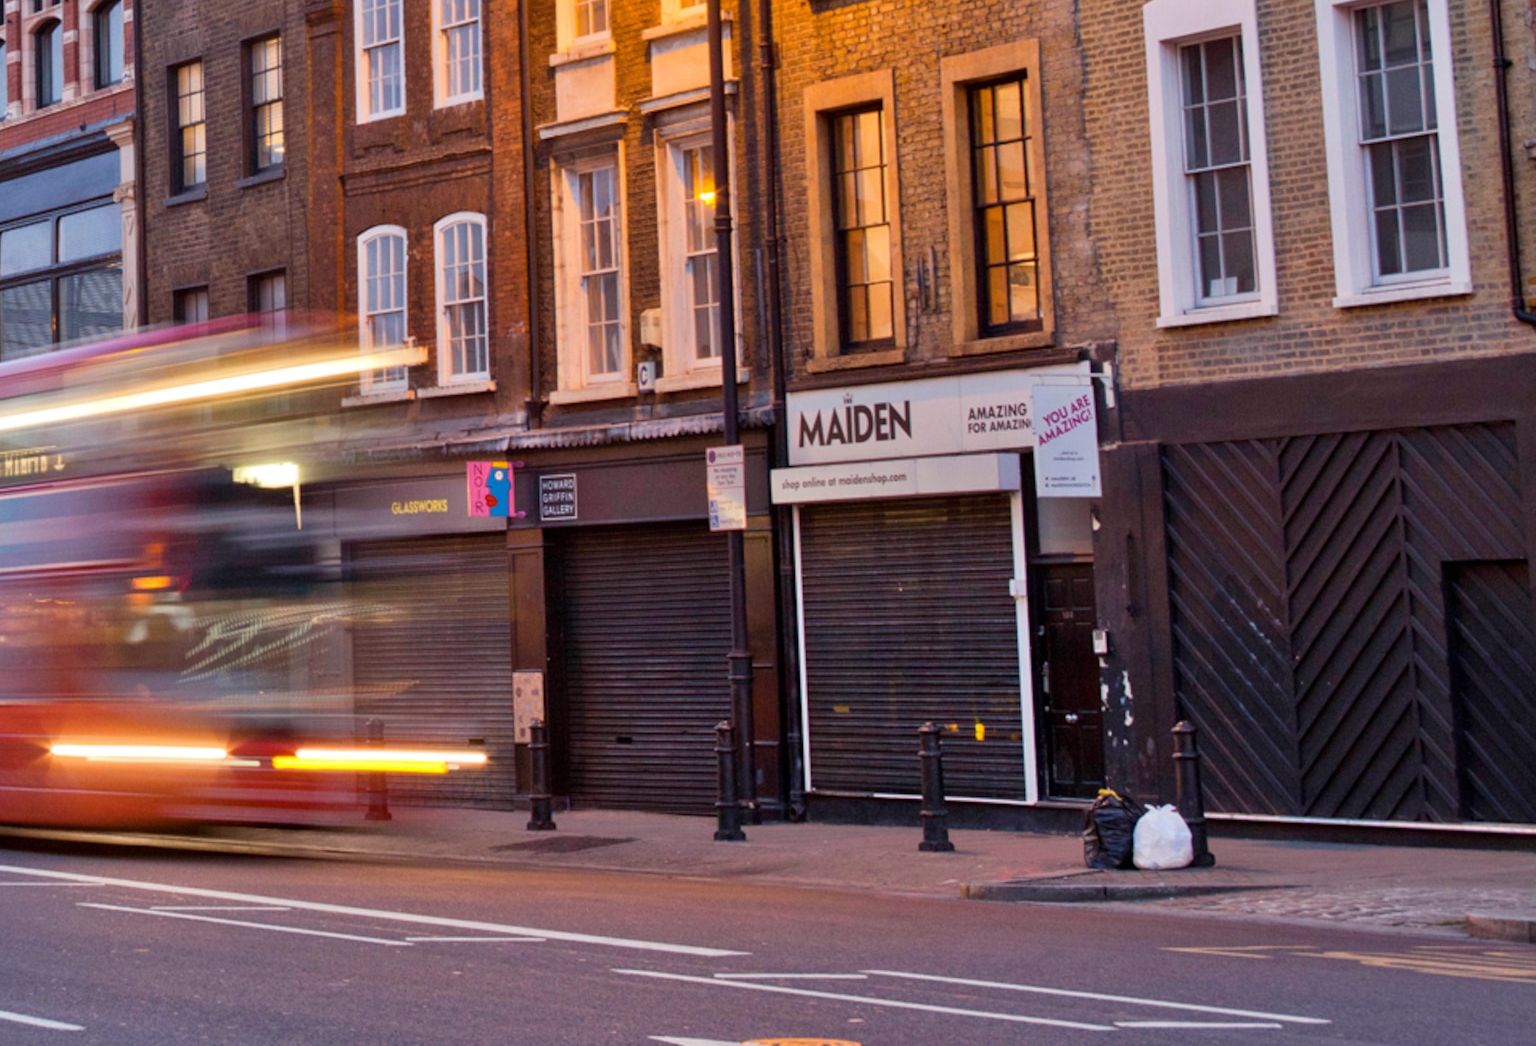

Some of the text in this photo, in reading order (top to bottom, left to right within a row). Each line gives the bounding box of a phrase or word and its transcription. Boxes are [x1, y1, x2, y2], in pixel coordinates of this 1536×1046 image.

[968, 403, 1027, 421] AMAZING
[1042, 394, 1091, 427] YOU ARE
[799, 400, 912, 448] MAIDEN
[967, 423, 986, 434] FOR
[1037, 408, 1093, 447] AMAZING!
[473, 464, 484, 514] NOIR
[542, 479, 574, 491] HOWARD
[782, 473, 907, 491] shop online at maidenshop.com
[391, 499, 448, 515] GLASSWORKS
[542, 492, 574, 504] GRIFFIN
[542, 504, 575, 515] GALLERY
